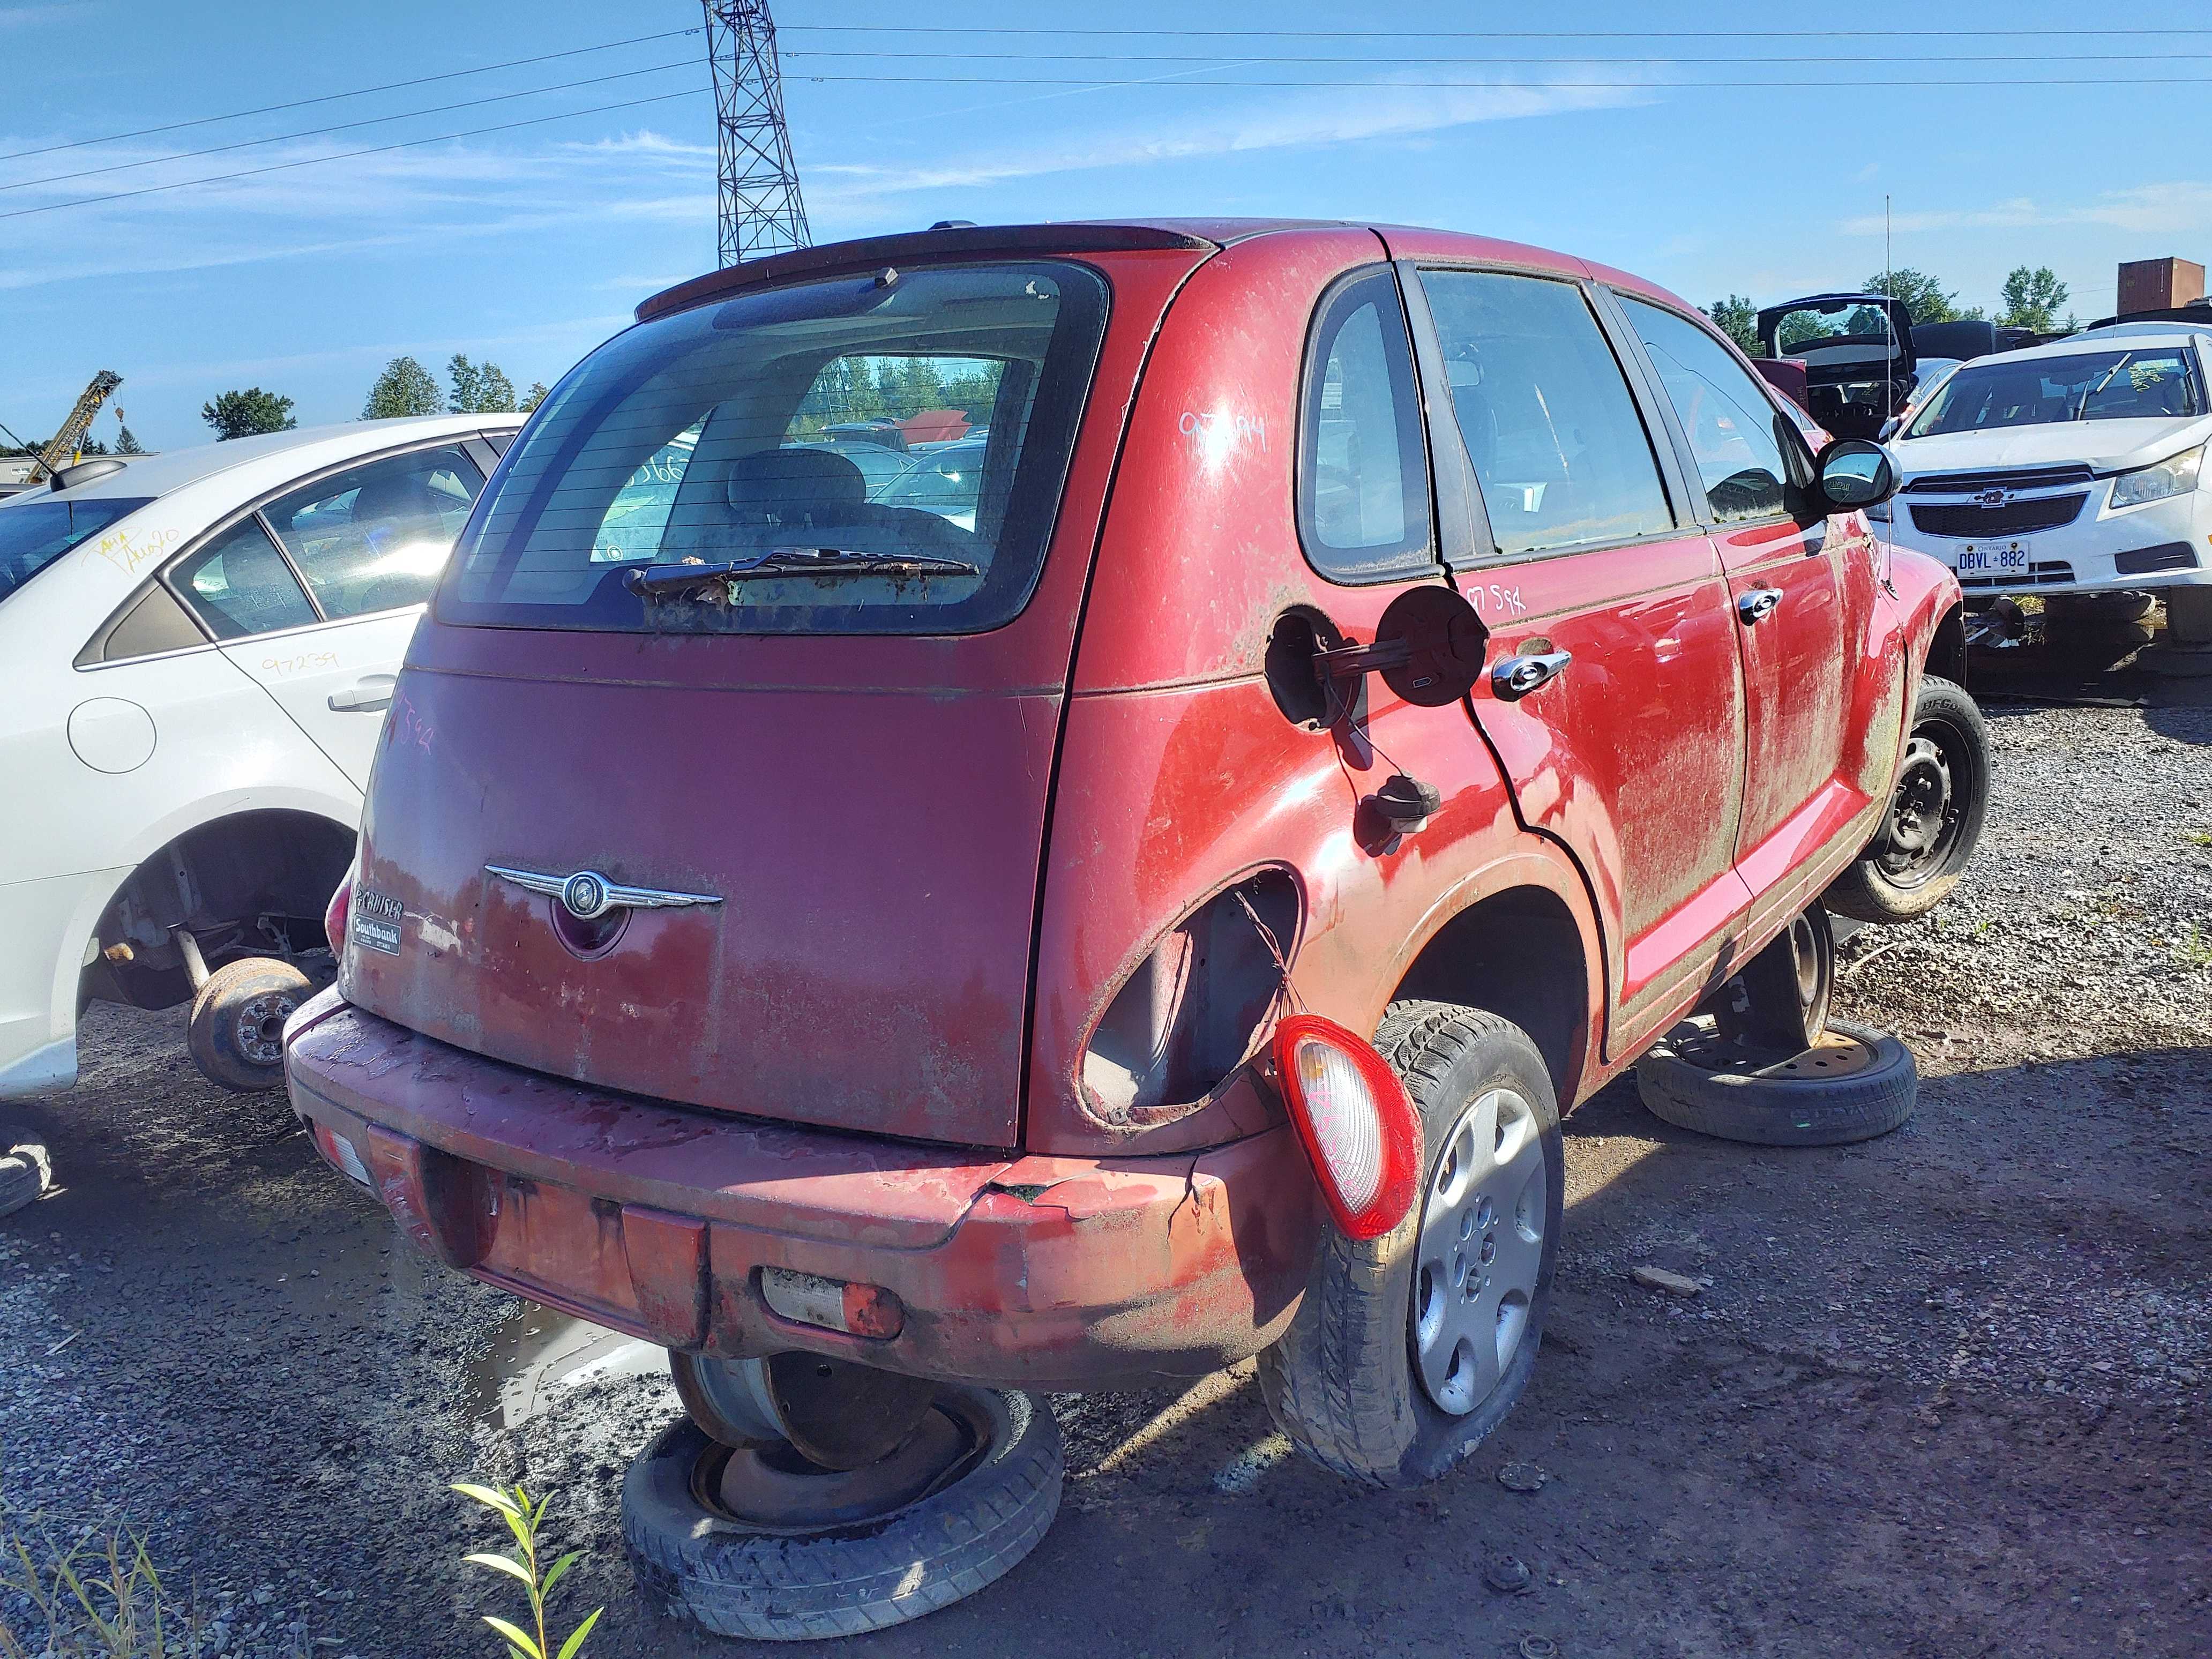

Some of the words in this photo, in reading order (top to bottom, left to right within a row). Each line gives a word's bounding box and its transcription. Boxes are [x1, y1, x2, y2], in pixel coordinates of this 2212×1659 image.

[261, 652, 339, 677] 97239
[363, 891, 403, 921] CRUISER
[355, 917, 398, 945] Southbank
